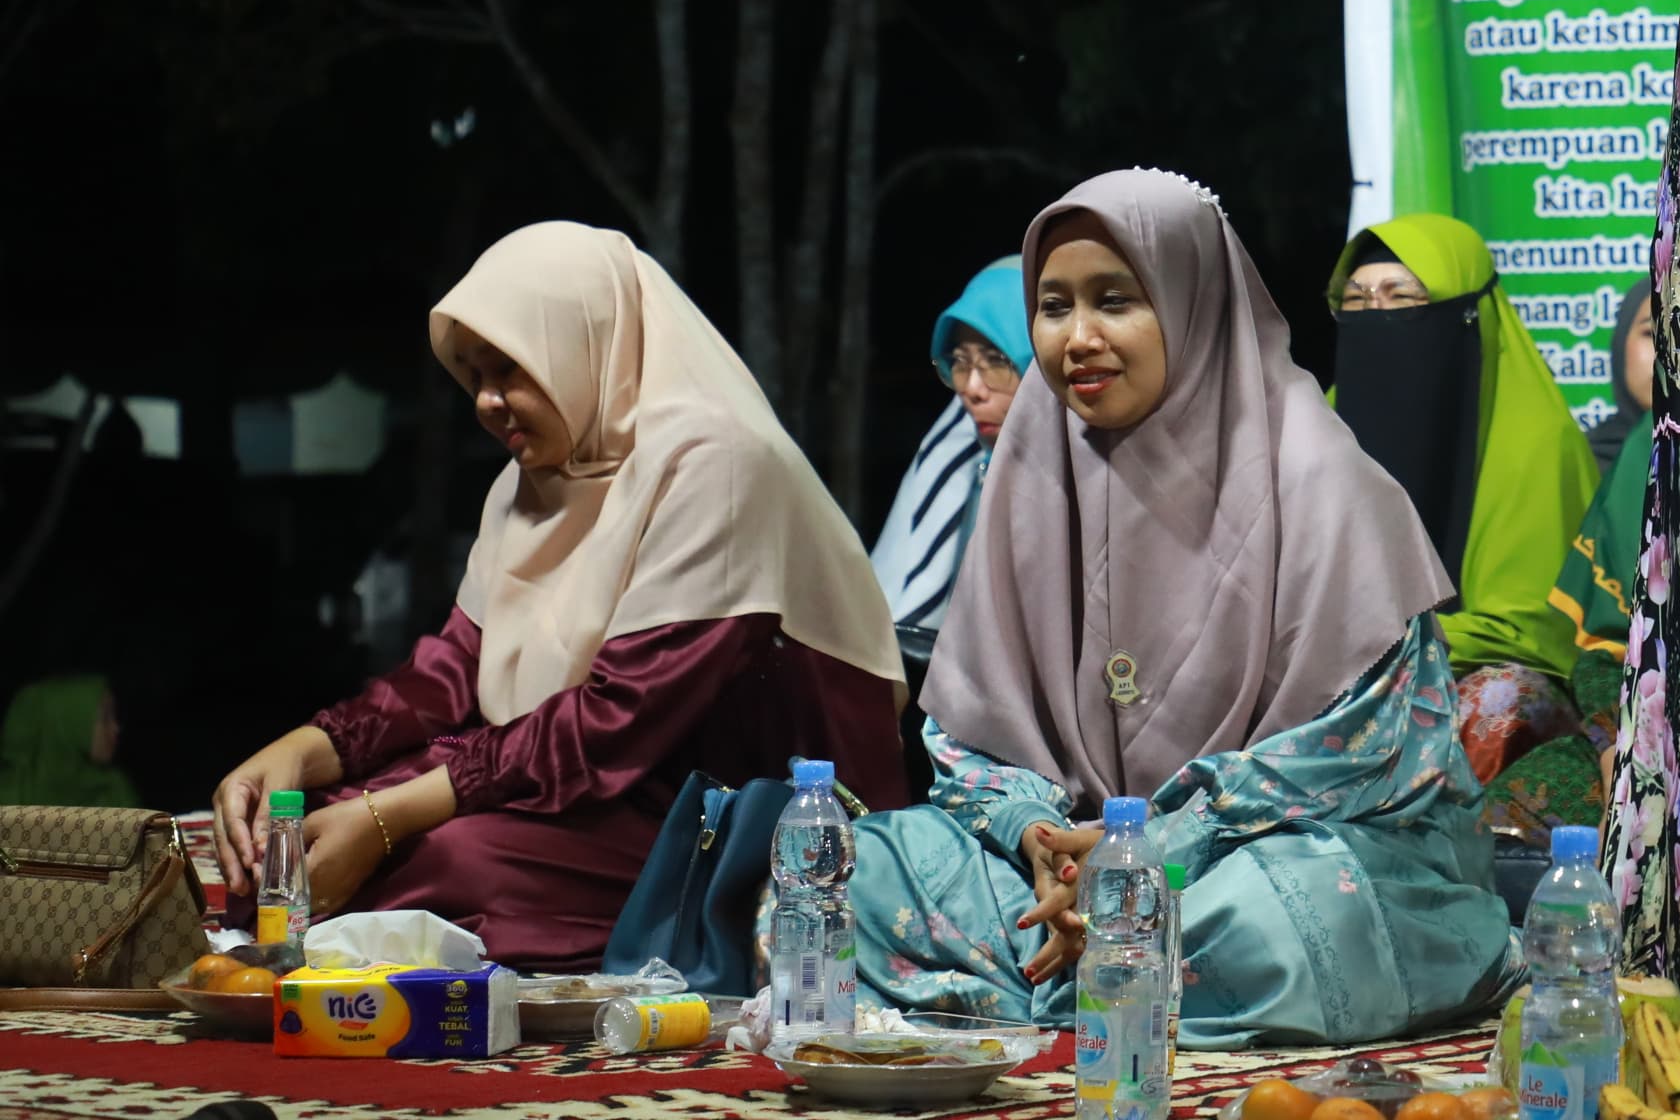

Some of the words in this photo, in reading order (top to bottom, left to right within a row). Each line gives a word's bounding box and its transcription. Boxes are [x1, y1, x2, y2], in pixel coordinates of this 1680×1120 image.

[1469, 21, 1538, 49] atau
[1508, 73, 1625, 102] karena
[1540, 182, 1605, 211] kita
[1528, 1073, 1543, 1092] Le
